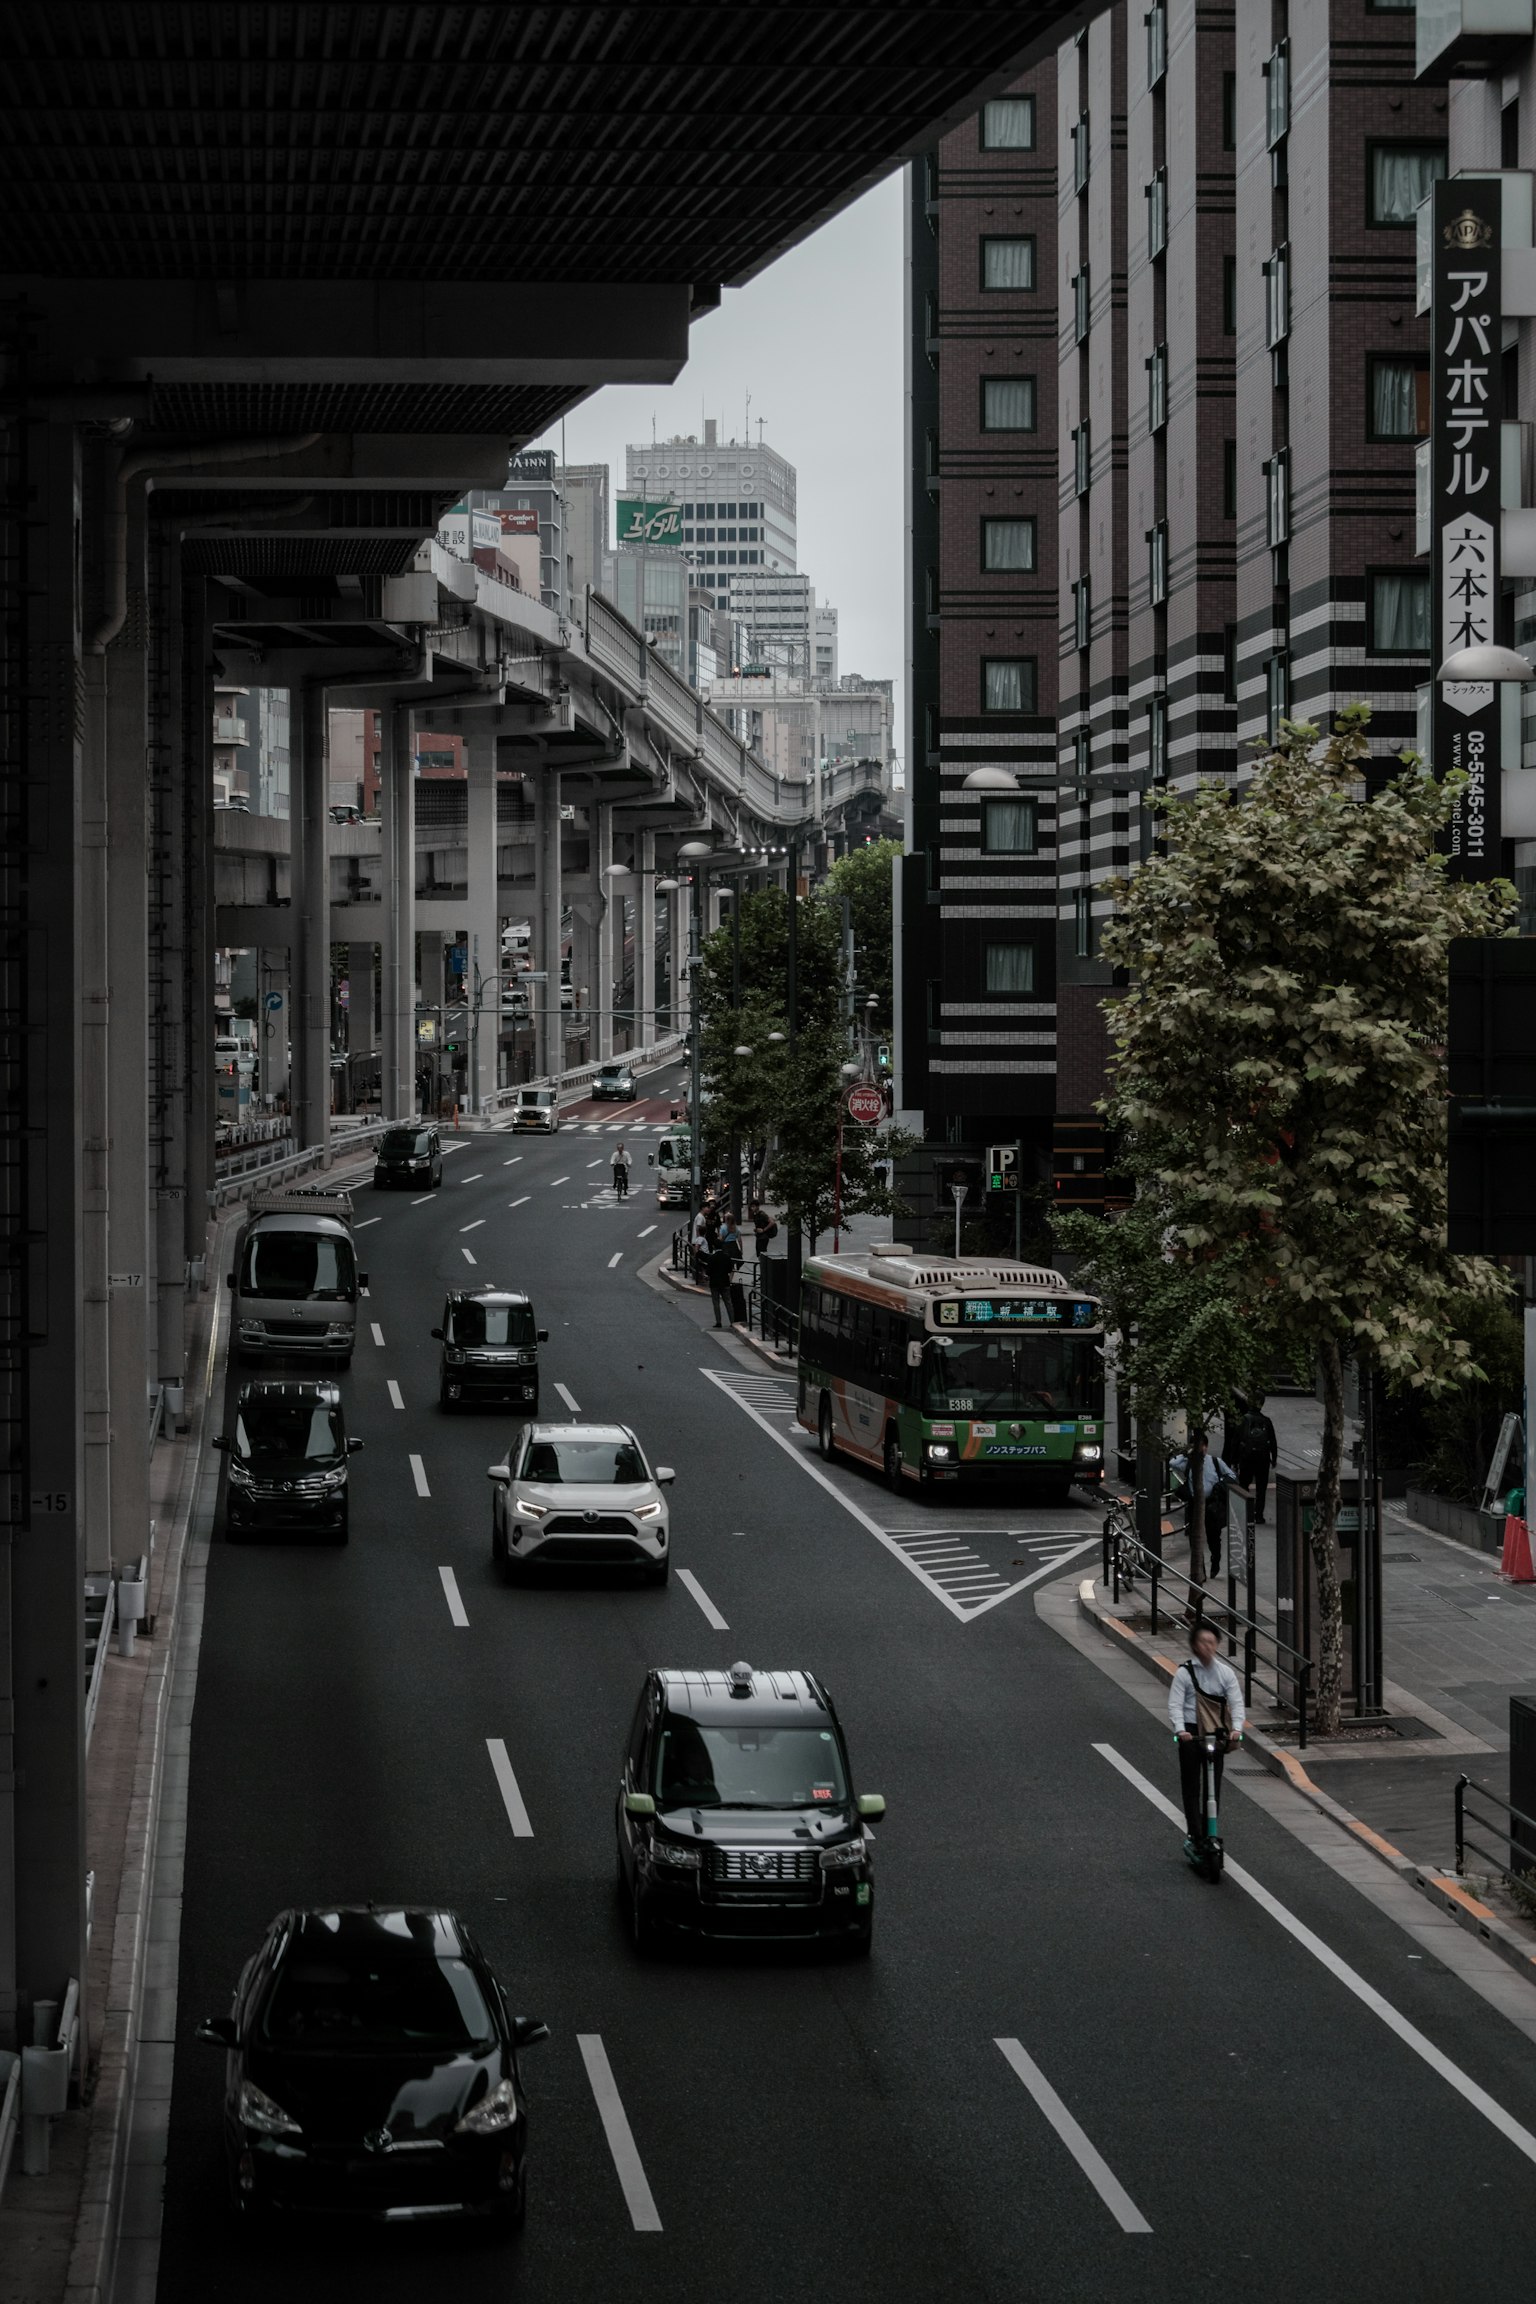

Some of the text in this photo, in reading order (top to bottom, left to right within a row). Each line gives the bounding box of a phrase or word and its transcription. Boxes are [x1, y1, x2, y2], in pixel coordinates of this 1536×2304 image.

[1445, 271, 1491, 496] アパホテル
[525, 458, 547, 467] INN
[623, 507, 680, 540] エイブル
[1449, 528, 1488, 648] 六本木
[1452, 732, 1465, 856] www.otel.com
[1467, 730, 1485, 857] 03-5545-3011
[852, 1098, 880, 1112] 消火栓
[1000, 1150, 1015, 1171] P
[950, 1399, 973, 1411] E388
[986, 1446, 1047, 1454] ノンステップバス
